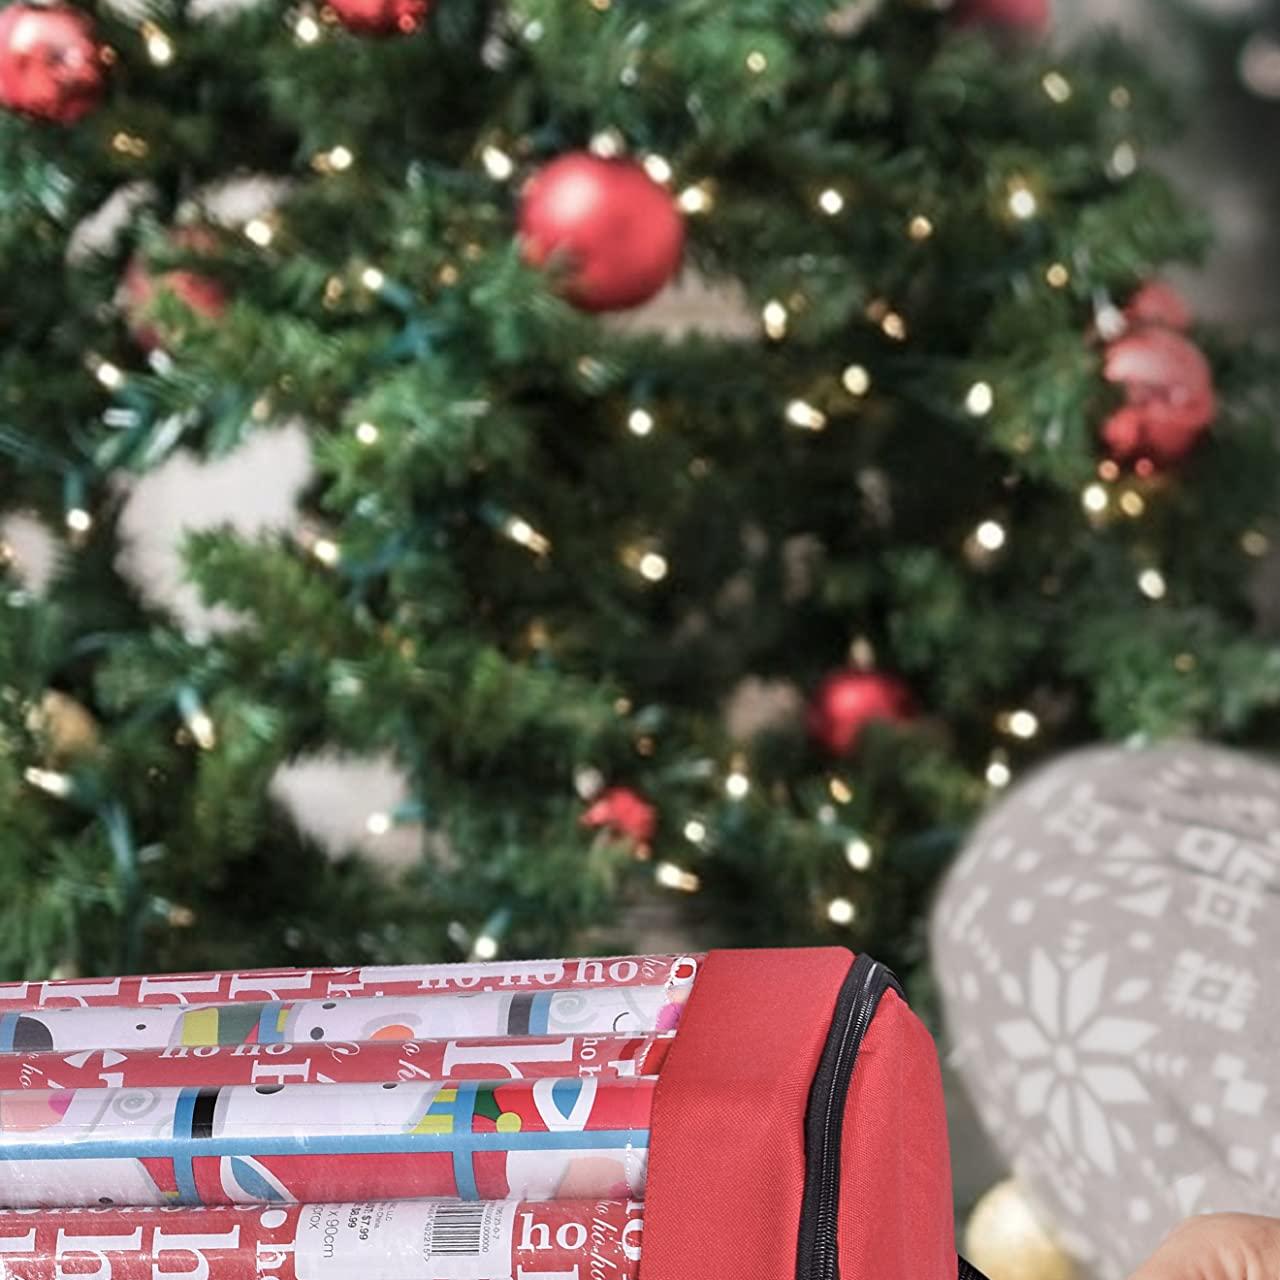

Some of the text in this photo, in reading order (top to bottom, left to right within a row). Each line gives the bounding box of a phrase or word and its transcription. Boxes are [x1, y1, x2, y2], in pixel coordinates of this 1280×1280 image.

[347, 1207, 361, 1229] $8.99
[359, 1215, 372, 1240] $7.99
[516, 1213, 588, 1250] ho
[323, 1219, 341, 1258] 90cm
